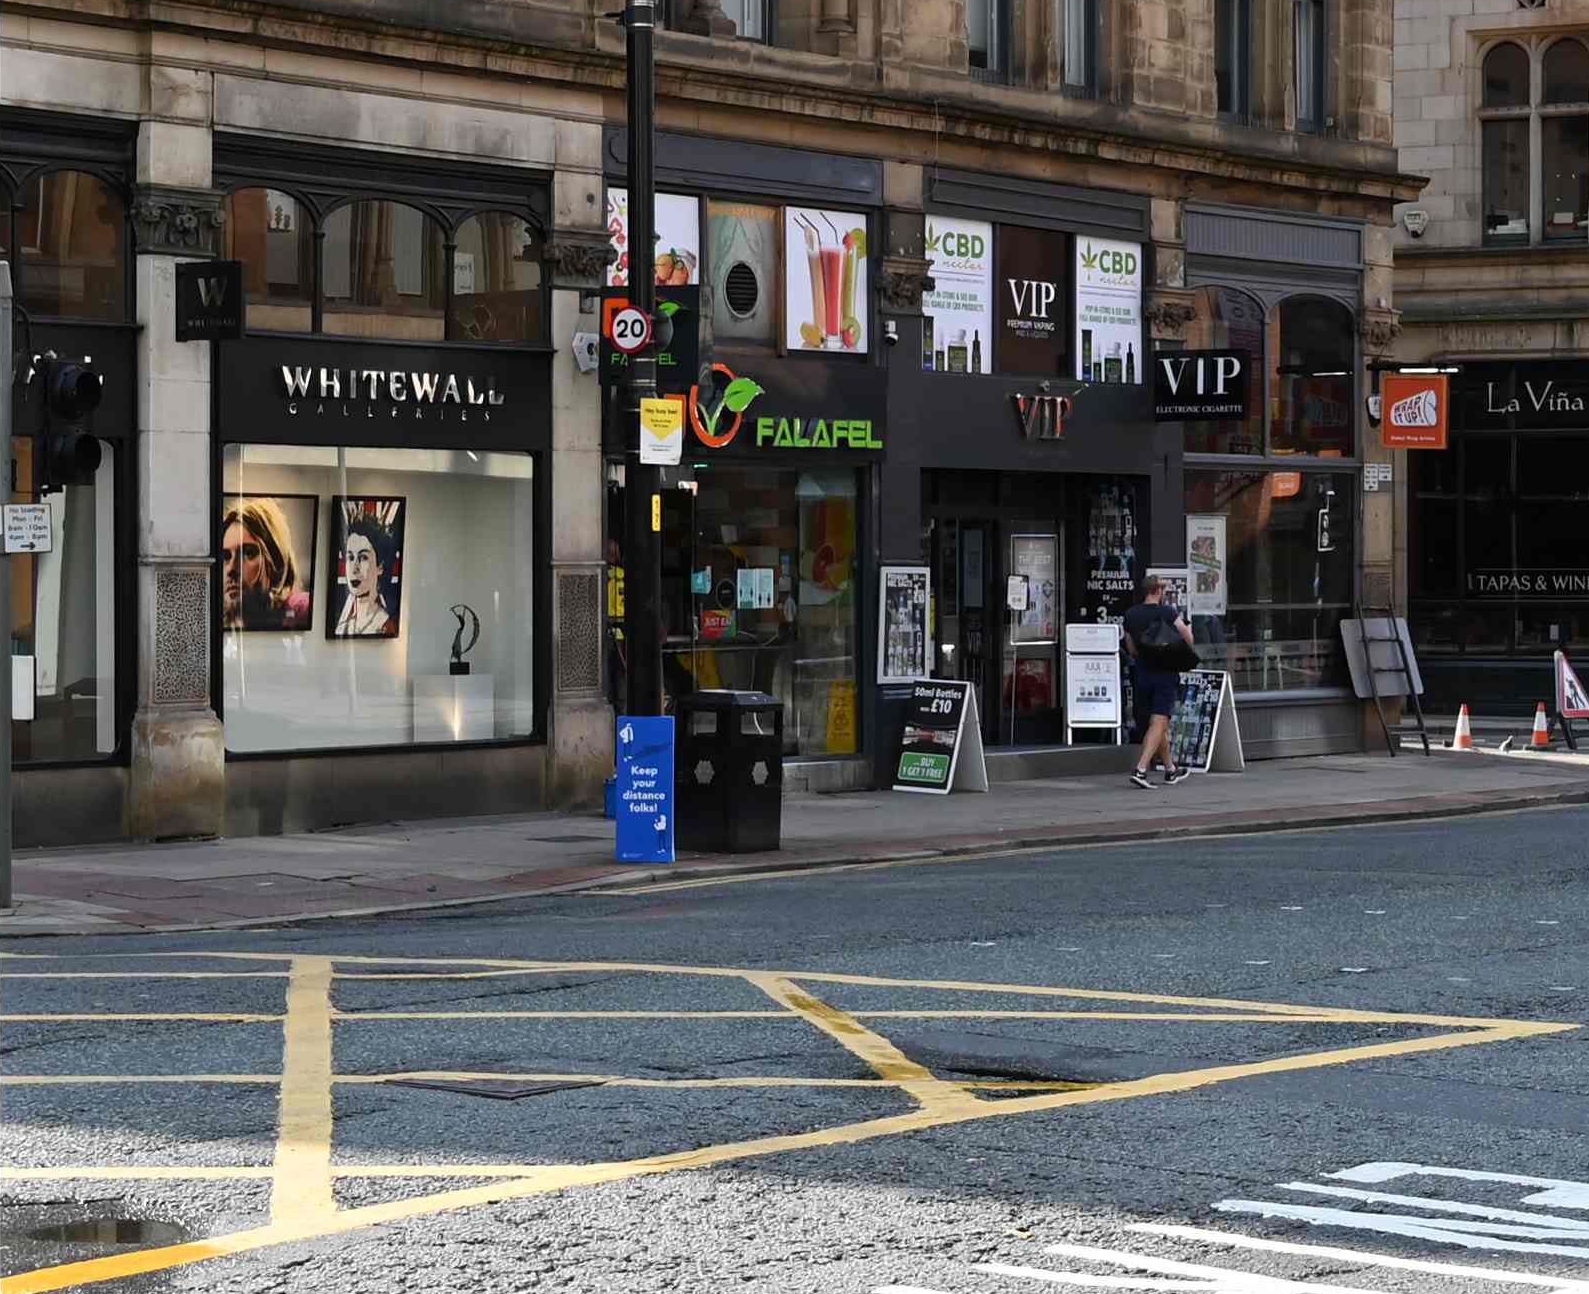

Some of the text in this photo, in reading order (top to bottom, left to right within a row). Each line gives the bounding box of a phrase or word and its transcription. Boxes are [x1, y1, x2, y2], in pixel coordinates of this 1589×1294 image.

[942, 231, 985, 259] CBD
[1099, 250, 1137, 275] CBD
[1008, 278, 1055, 318] VIP
[616, 319, 645, 338] 20
[611, 353, 677, 366] FAEL
[282, 365, 505, 405] WHITEWALL
[1158, 356, 1241, 396] VIP
[1487, 380, 1585, 413] La Viña
[288, 403, 491, 421] GALLERIES
[756, 418, 883, 449] FALAFEL
[1087, 580, 1134, 591] NIC SALTS
[1476, 575, 1531, 591] TAPAS
[1535, 575, 1548, 591] &
[1097, 606, 1108, 624] 3
[930, 699, 953, 714] £10
[631, 765, 658, 777] Keep
[633, 779, 656, 789] your
[622, 790, 665, 800] distance
[629, 802, 658, 813] folks!
